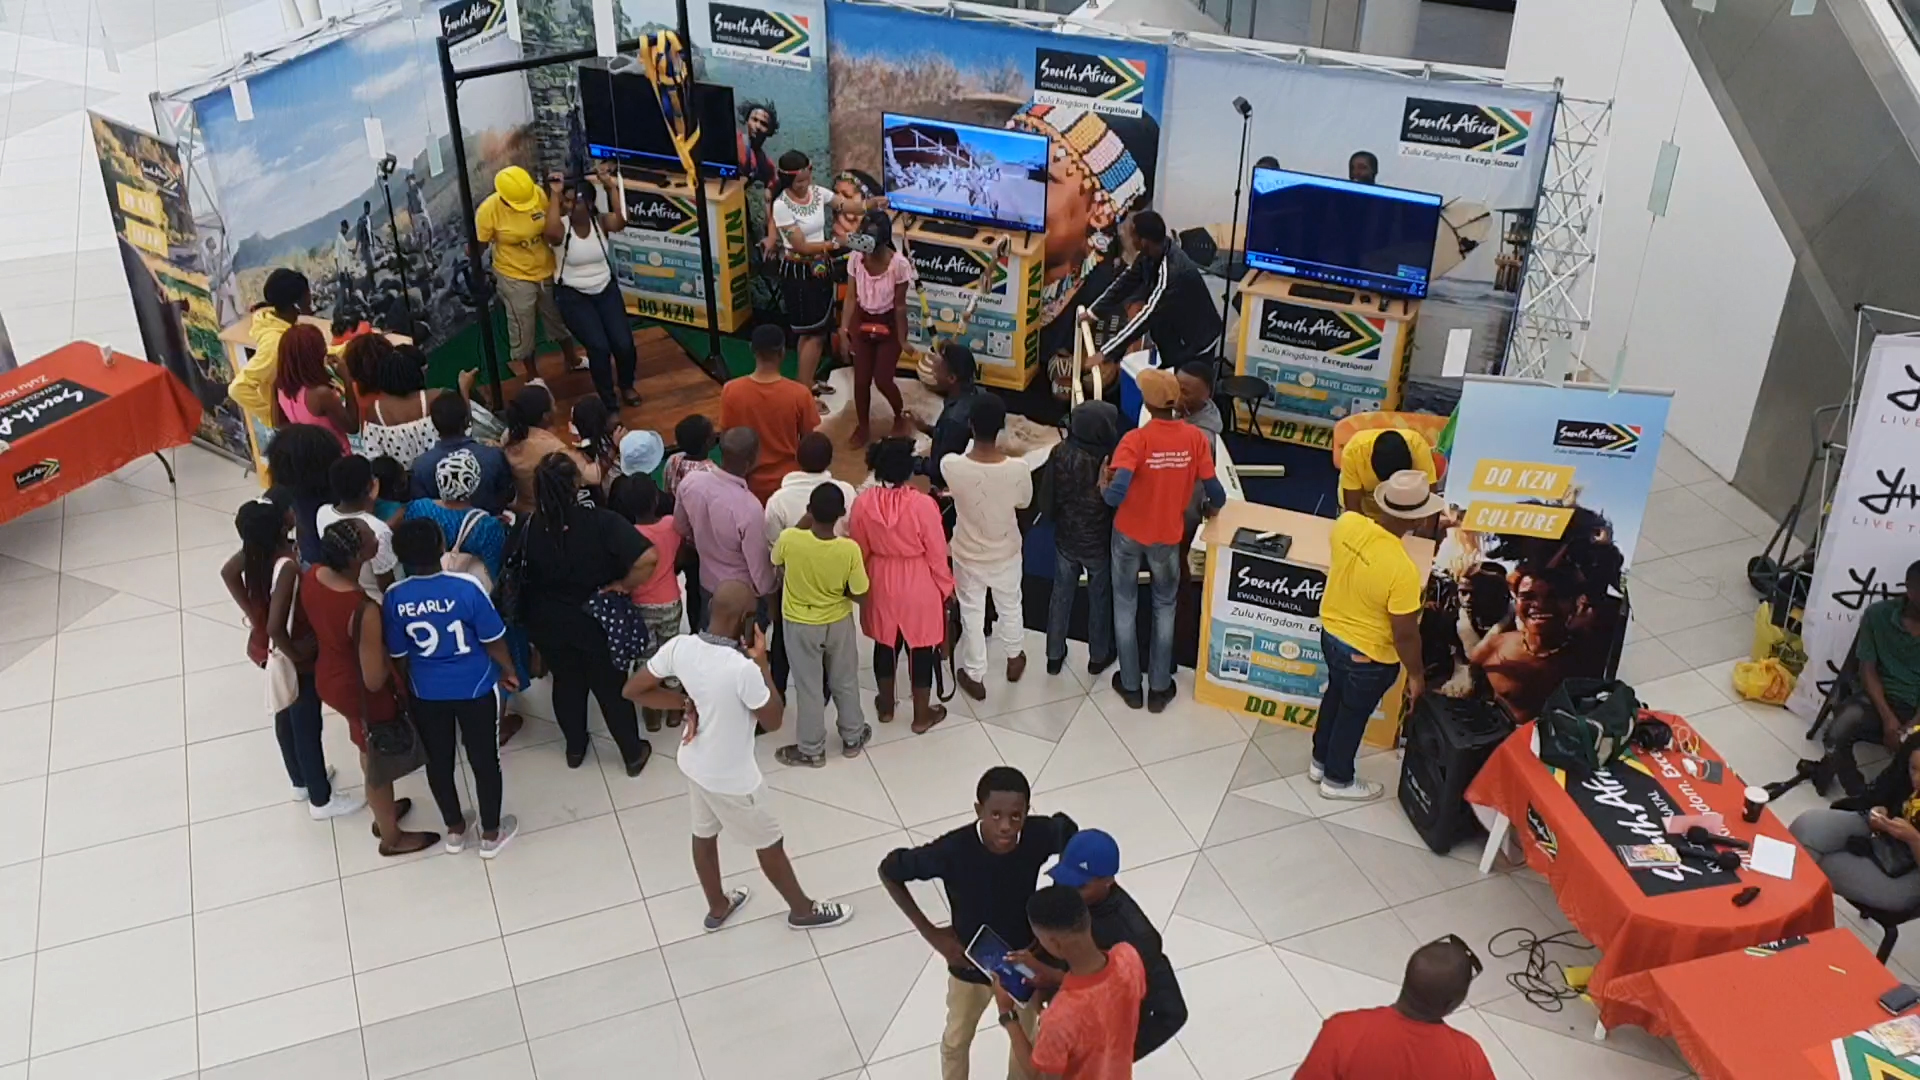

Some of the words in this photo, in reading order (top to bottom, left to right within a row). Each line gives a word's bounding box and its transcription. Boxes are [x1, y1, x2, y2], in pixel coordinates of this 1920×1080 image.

[714, 12, 749, 34] South
[750, 17, 785, 38] Africa
[1040, 58, 1078, 80] South
[1078, 63, 1117, 84] Africa
[1092, 102, 1139, 116] Exceptional
[1408, 108, 1452, 131] South
[1452, 113, 1497, 136] Africa
[1464, 154, 1519, 169] Excepional
[646, 201, 682, 220] Africa
[724, 207, 747, 270] KZN
[944, 254, 981, 276] Africa
[730, 272, 749, 313] DO
[1027, 259, 1042, 326] KZN
[637, 297, 658, 315] DO
[662, 301, 695, 324] KZN
[1267, 310, 1308, 332] South
[1308, 317, 1351, 340] Africa
[1024, 328, 1039, 370] DO
[1321, 356, 1373, 372] Exceptional
[1316, 377, 1341, 391] TRAVEL
[1363, 385, 1380, 396] APP
[12, 387, 84, 424] South
[1271, 419, 1298, 440] DO
[1559, 425, 1588, 440] South
[1484, 466, 1513, 486] DO
[1516, 469, 1558, 491] KZN
[1475, 507, 1559, 533] CULTURE
[1852, 515, 1895, 531] LIVE
[1237, 565, 1290, 597] South
[1290, 577, 1325, 601] Afr
[397, 598, 456, 617] PEARLY
[1230, 606, 1255, 620] Zulu
[1255, 611, 1305, 631] Kingdom.
[1826, 610, 1857, 624] LIV
[405, 619, 472, 657] 91
[1259, 639, 1277, 652] THE
[1244, 694, 1277, 717] DO
[1283, 702, 1319, 728] KZ
